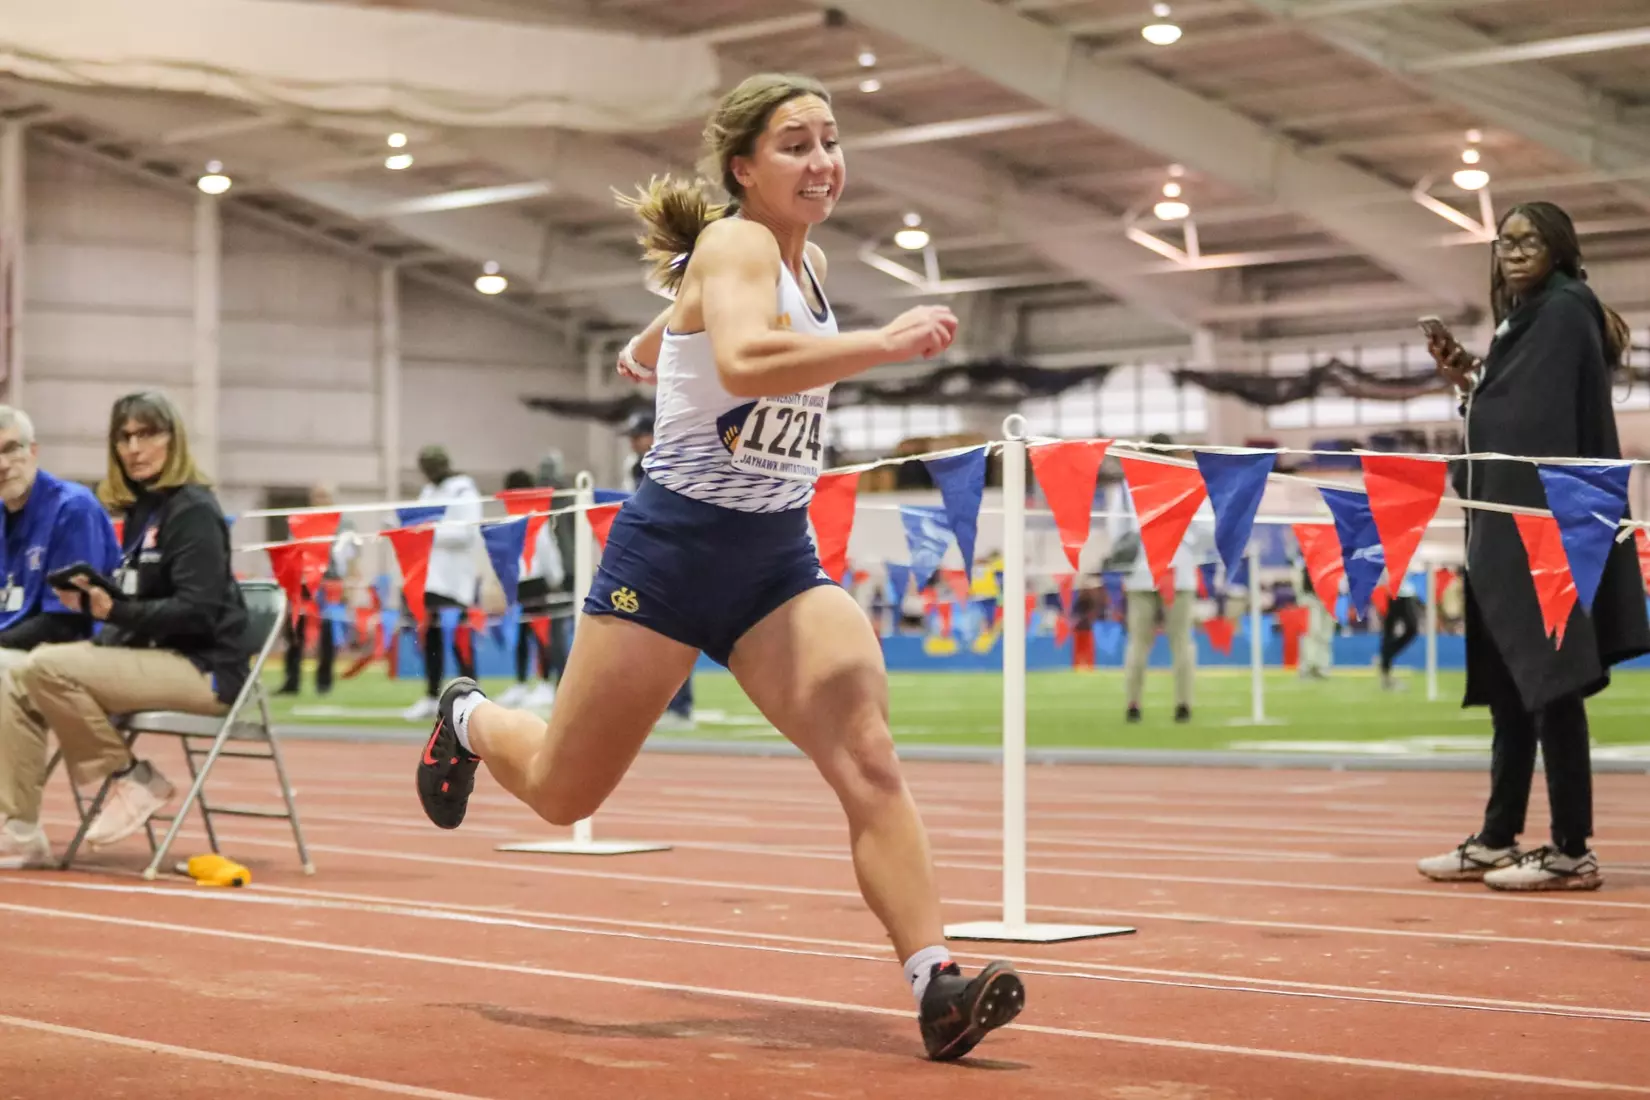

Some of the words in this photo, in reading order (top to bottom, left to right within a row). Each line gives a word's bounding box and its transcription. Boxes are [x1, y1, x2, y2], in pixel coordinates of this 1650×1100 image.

[743, 406, 822, 461] 1224
[740, 454, 778, 471] JAYHAWK
[780, 461, 818, 477] INVITATIONAL
